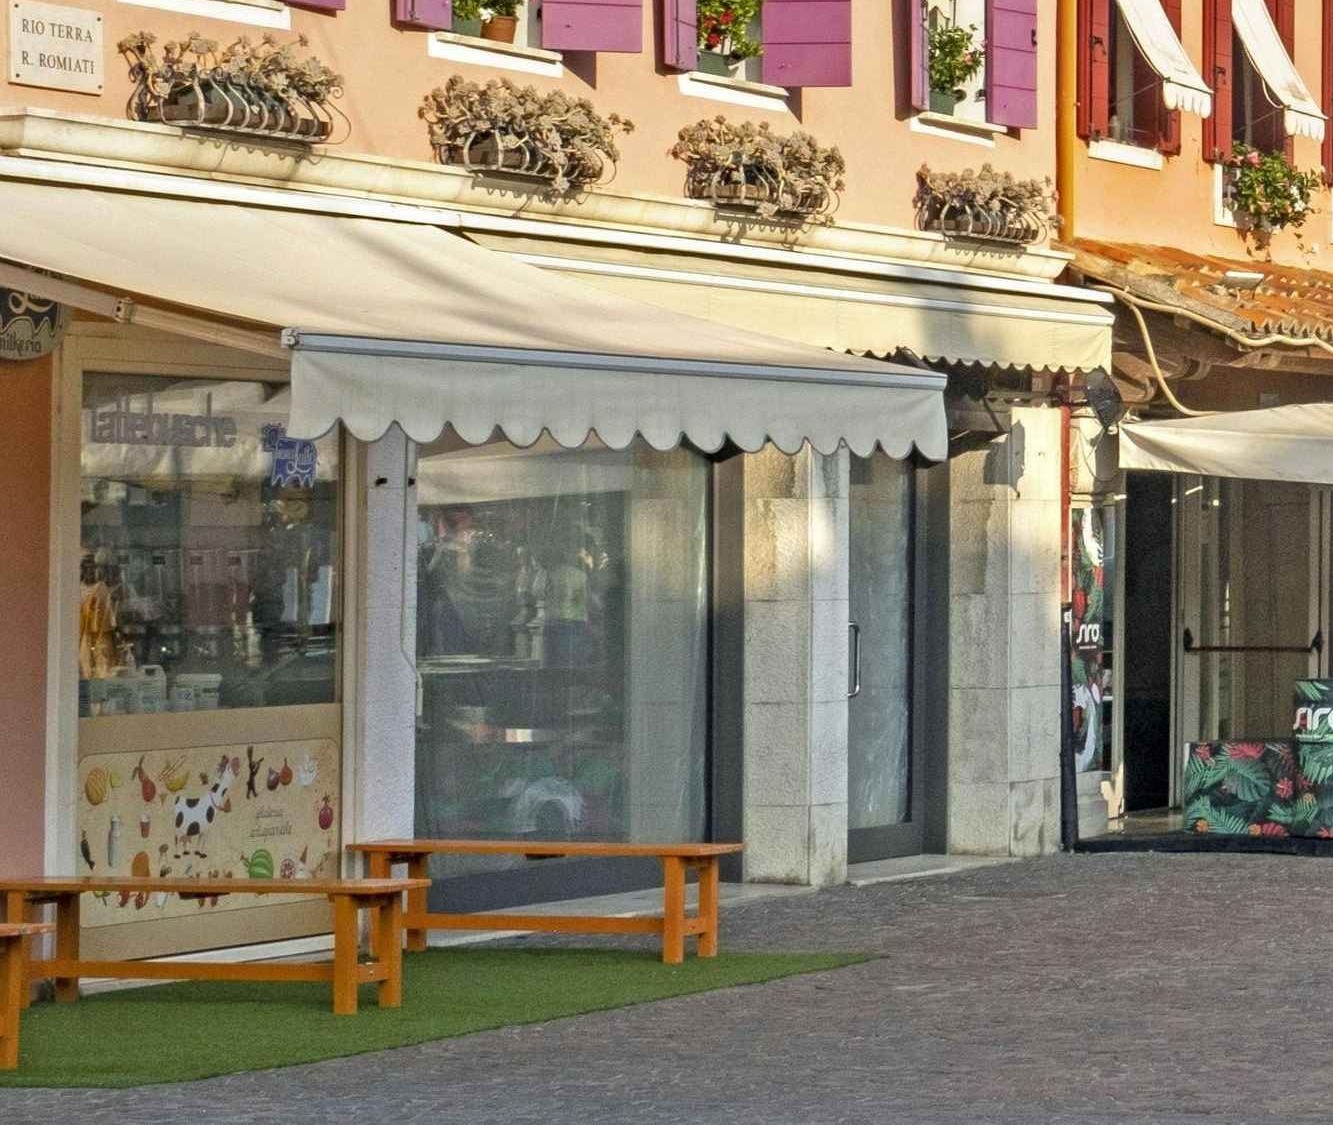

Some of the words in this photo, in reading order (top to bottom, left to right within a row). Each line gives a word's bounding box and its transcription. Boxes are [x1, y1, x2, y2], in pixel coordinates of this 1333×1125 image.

[22, 18, 45, 36] RIO
[49, 22, 93, 43] TERRA
[21, 50, 34, 66] R.
[39, 52, 95, 75] ROMIATI
